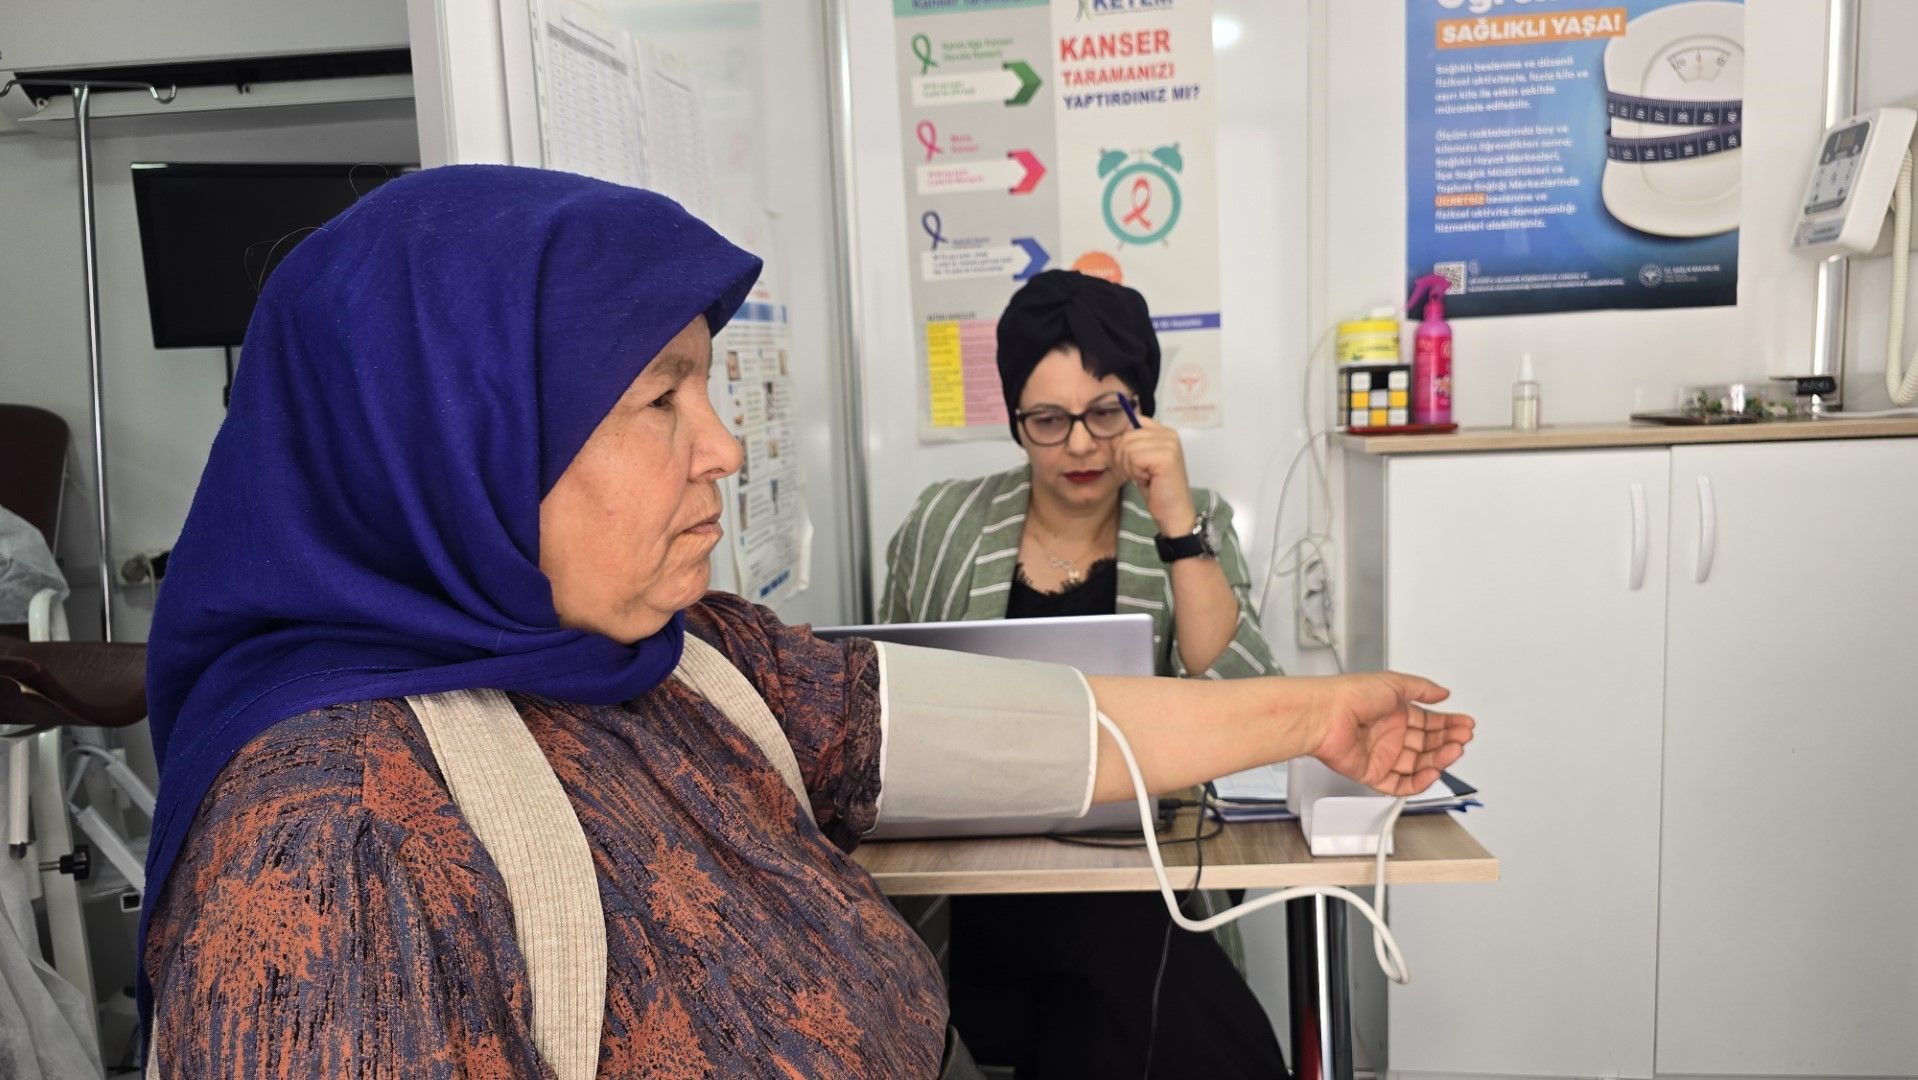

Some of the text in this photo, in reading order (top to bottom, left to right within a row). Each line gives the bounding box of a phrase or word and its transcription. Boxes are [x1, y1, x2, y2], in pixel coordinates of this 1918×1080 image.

[1442, 13, 1621, 44] SAĞLIKLI YAŞA!
[1060, 29, 1171, 62] KANSER
[1063, 63, 1175, 87] TARAMANIZI
[1524, 60, 1535, 69] ve
[1064, 84, 1200, 110] YAPTIRDINIZ MI?
